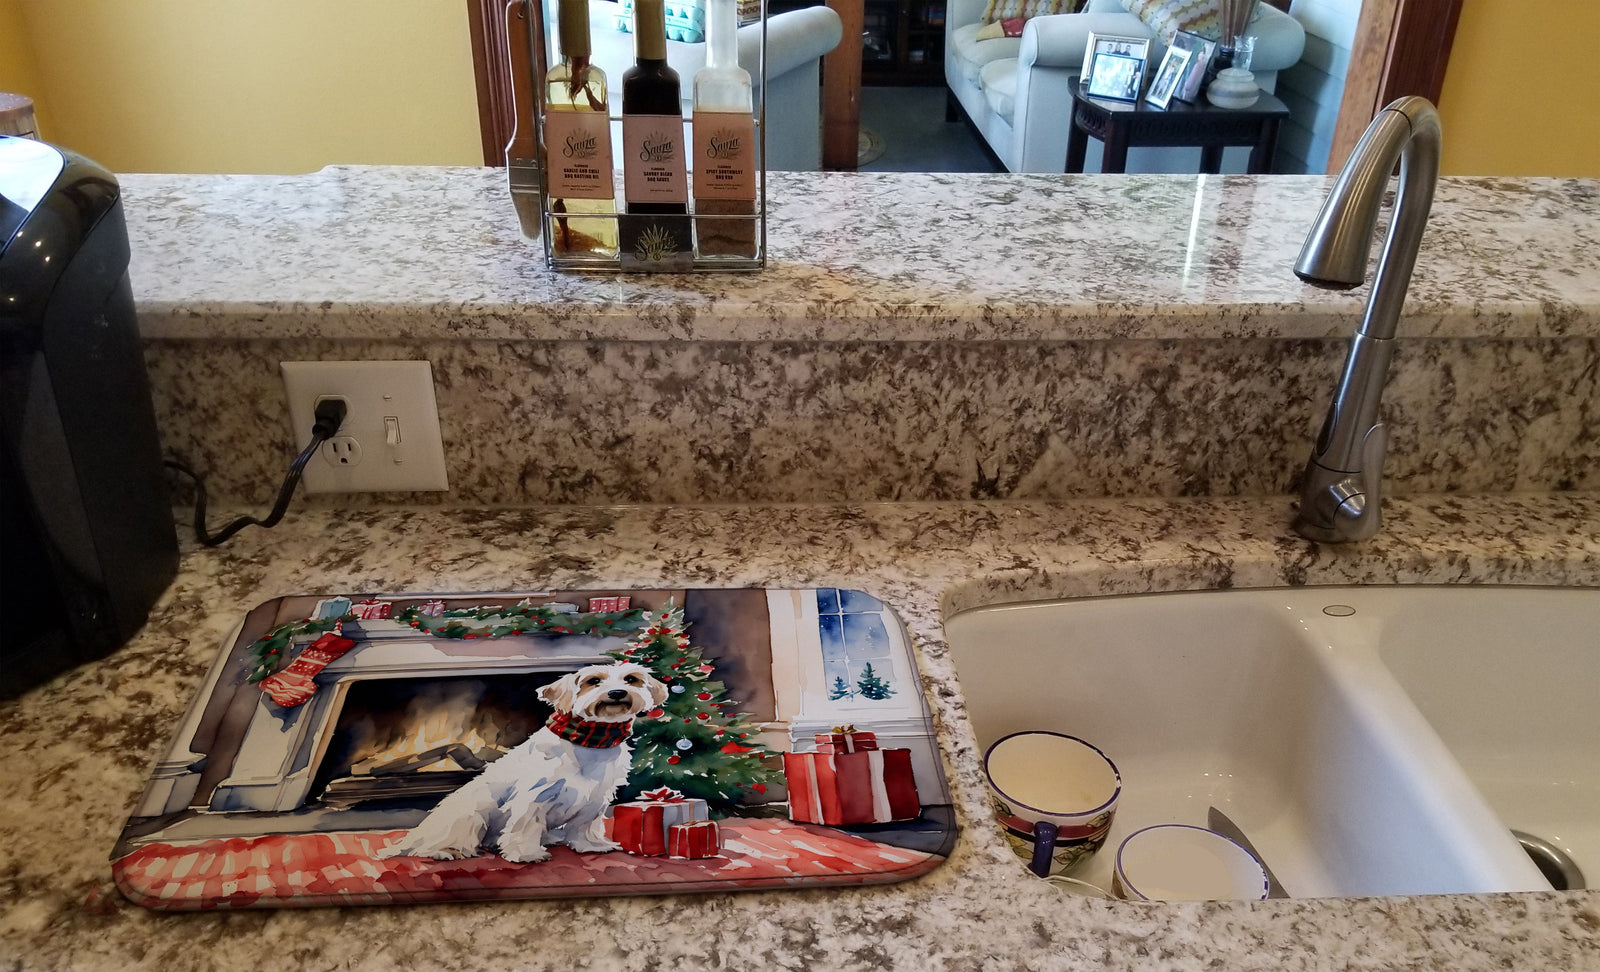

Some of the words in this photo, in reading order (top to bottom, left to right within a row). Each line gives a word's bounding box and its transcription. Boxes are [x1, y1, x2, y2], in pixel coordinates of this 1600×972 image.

[563, 136, 597, 158] Sauza
[640, 140, 673, 162] Sauza
[707, 136, 740, 159] Sauza
